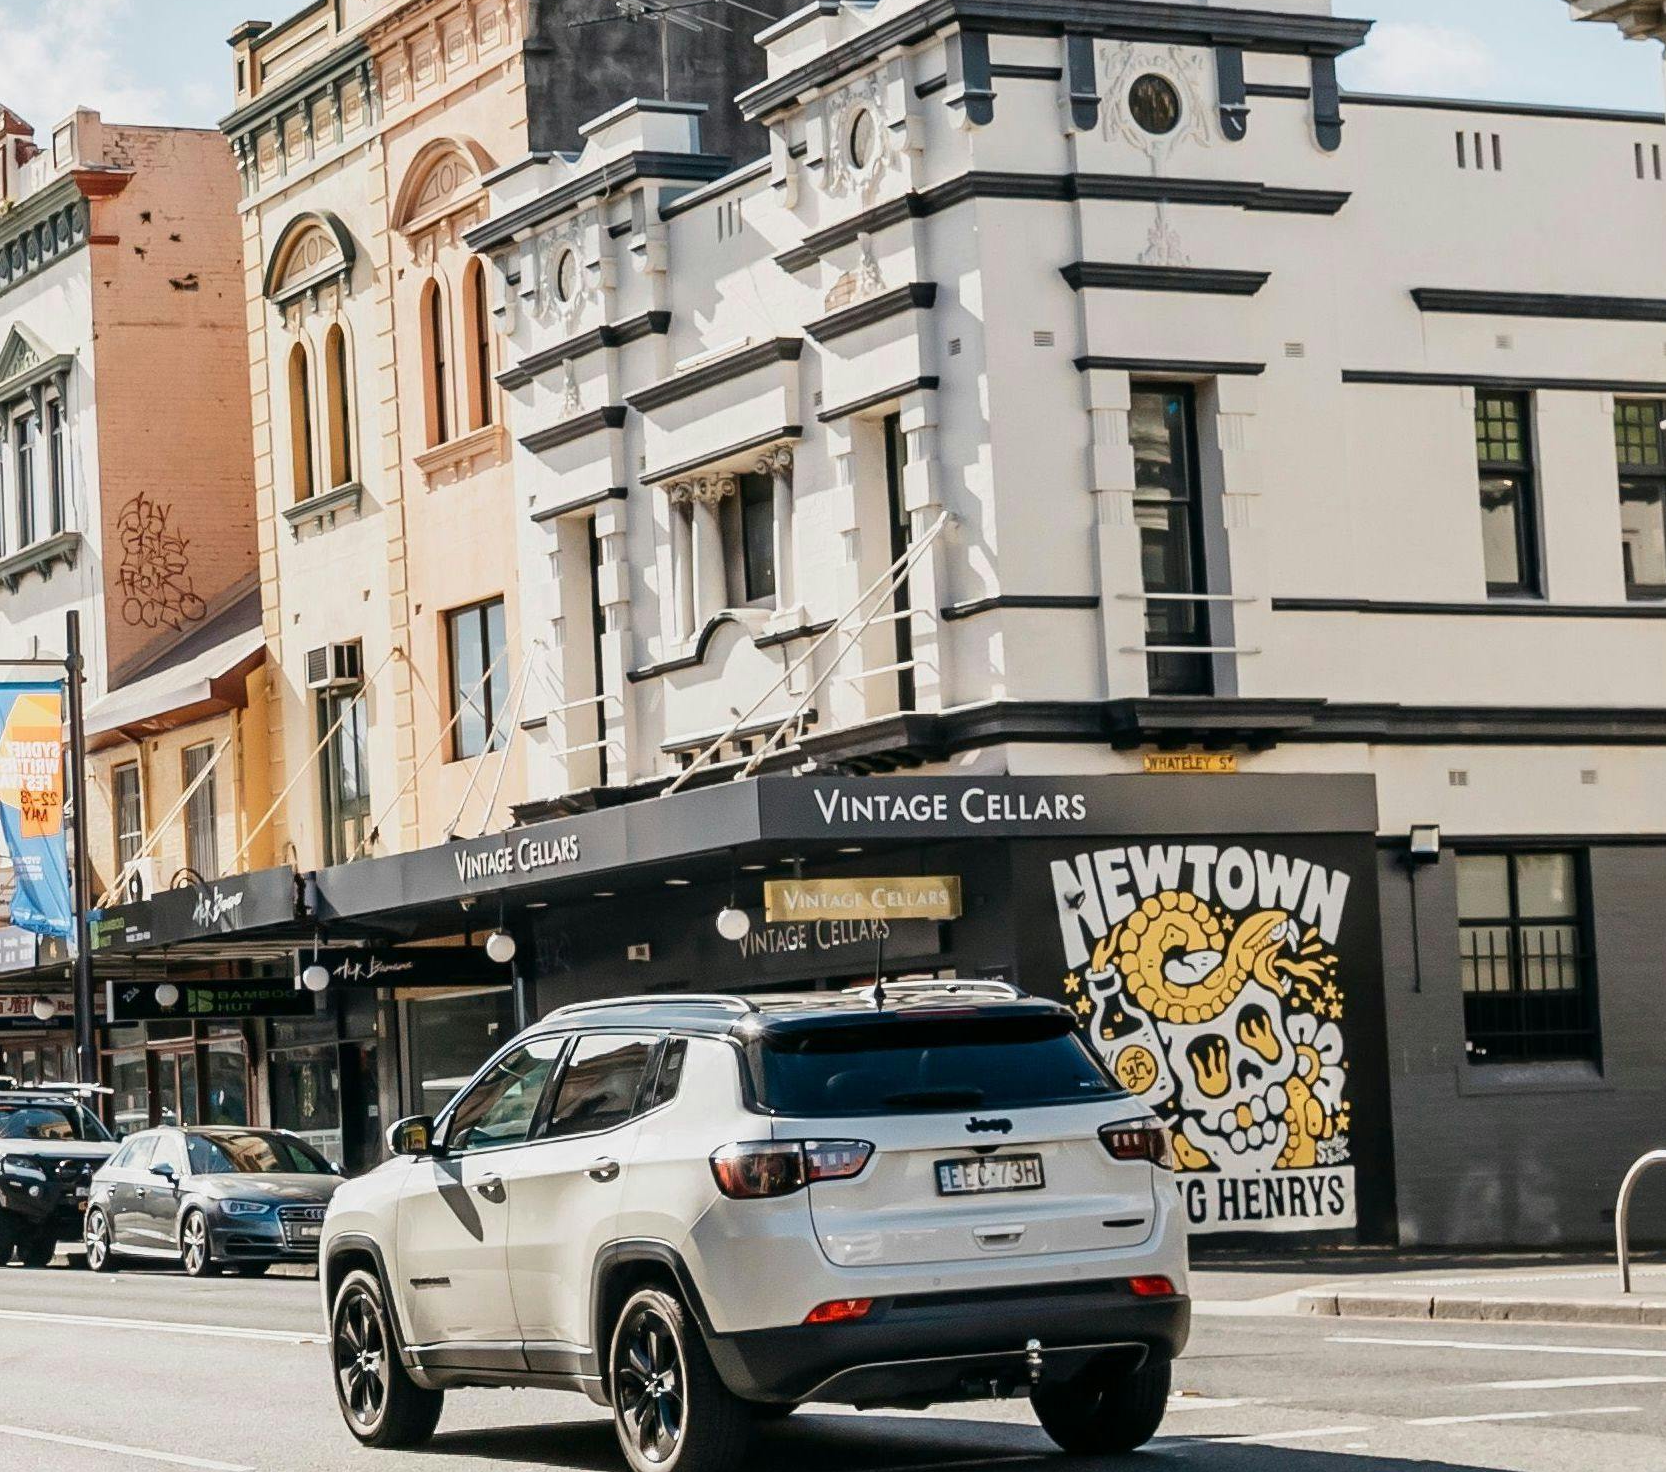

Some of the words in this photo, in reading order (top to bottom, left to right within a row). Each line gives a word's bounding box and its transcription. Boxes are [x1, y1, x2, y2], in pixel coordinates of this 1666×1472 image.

[814, 789, 948, 824] VINTAGE
[960, 787, 1086, 824] CELLARS
[454, 850, 514, 882] VINTAGE
[517, 834, 580, 875] CELLARS
[784, 889, 863, 910] VINTAGE
[871, 887, 950, 910] CELLARS
[1050, 844, 1351, 969] NEWTOWN
[738, 924, 808, 959] VINTAGE
[816, 918, 891, 950] CELLARS
[217, 989, 298, 999] BAMBOO
[217, 1002, 252, 1012] HUT
[1218, 1174, 1345, 1222] HENRYS
